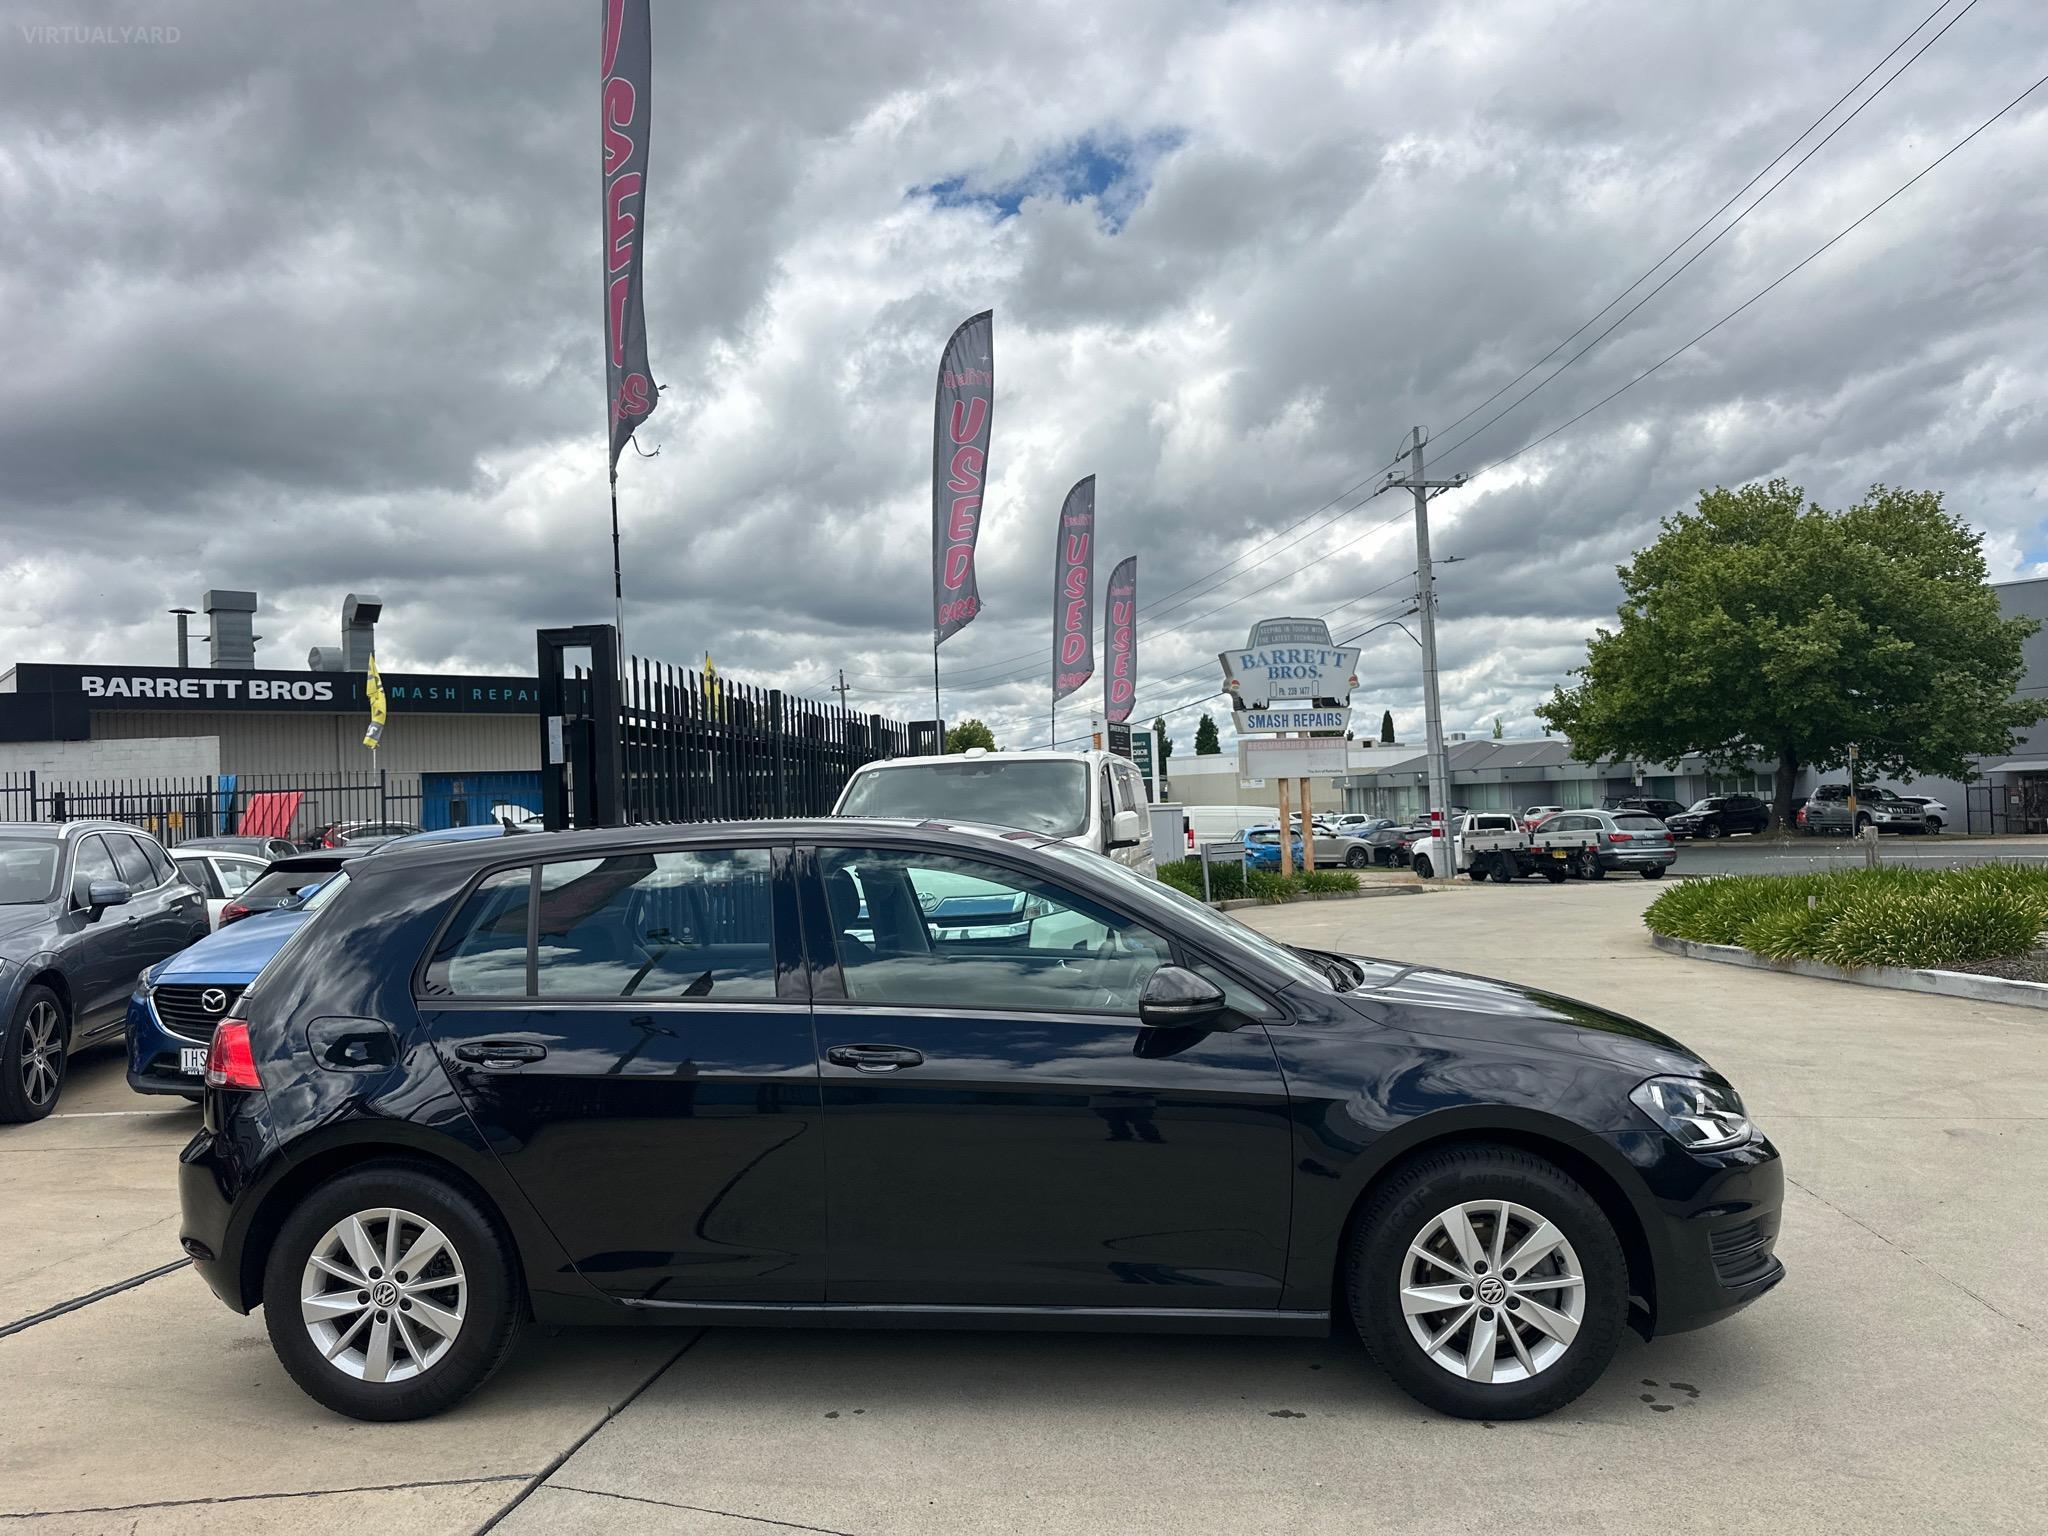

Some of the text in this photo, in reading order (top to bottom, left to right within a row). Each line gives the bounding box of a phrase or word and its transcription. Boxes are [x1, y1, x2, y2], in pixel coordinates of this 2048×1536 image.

[944, 396, 988, 591] USED
[938, 596, 977, 626] CARS
[1061, 533, 1090, 666] USED
[1110, 601, 1133, 704] USED
[1240, 648, 1347, 671] BARRETT
[1268, 665, 1323, 680] BROS.
[82, 676, 334, 701] BARRETT BROS
[391, 686, 456, 700] MASH
[1248, 712, 1342, 729] SMASH REPAIRS
